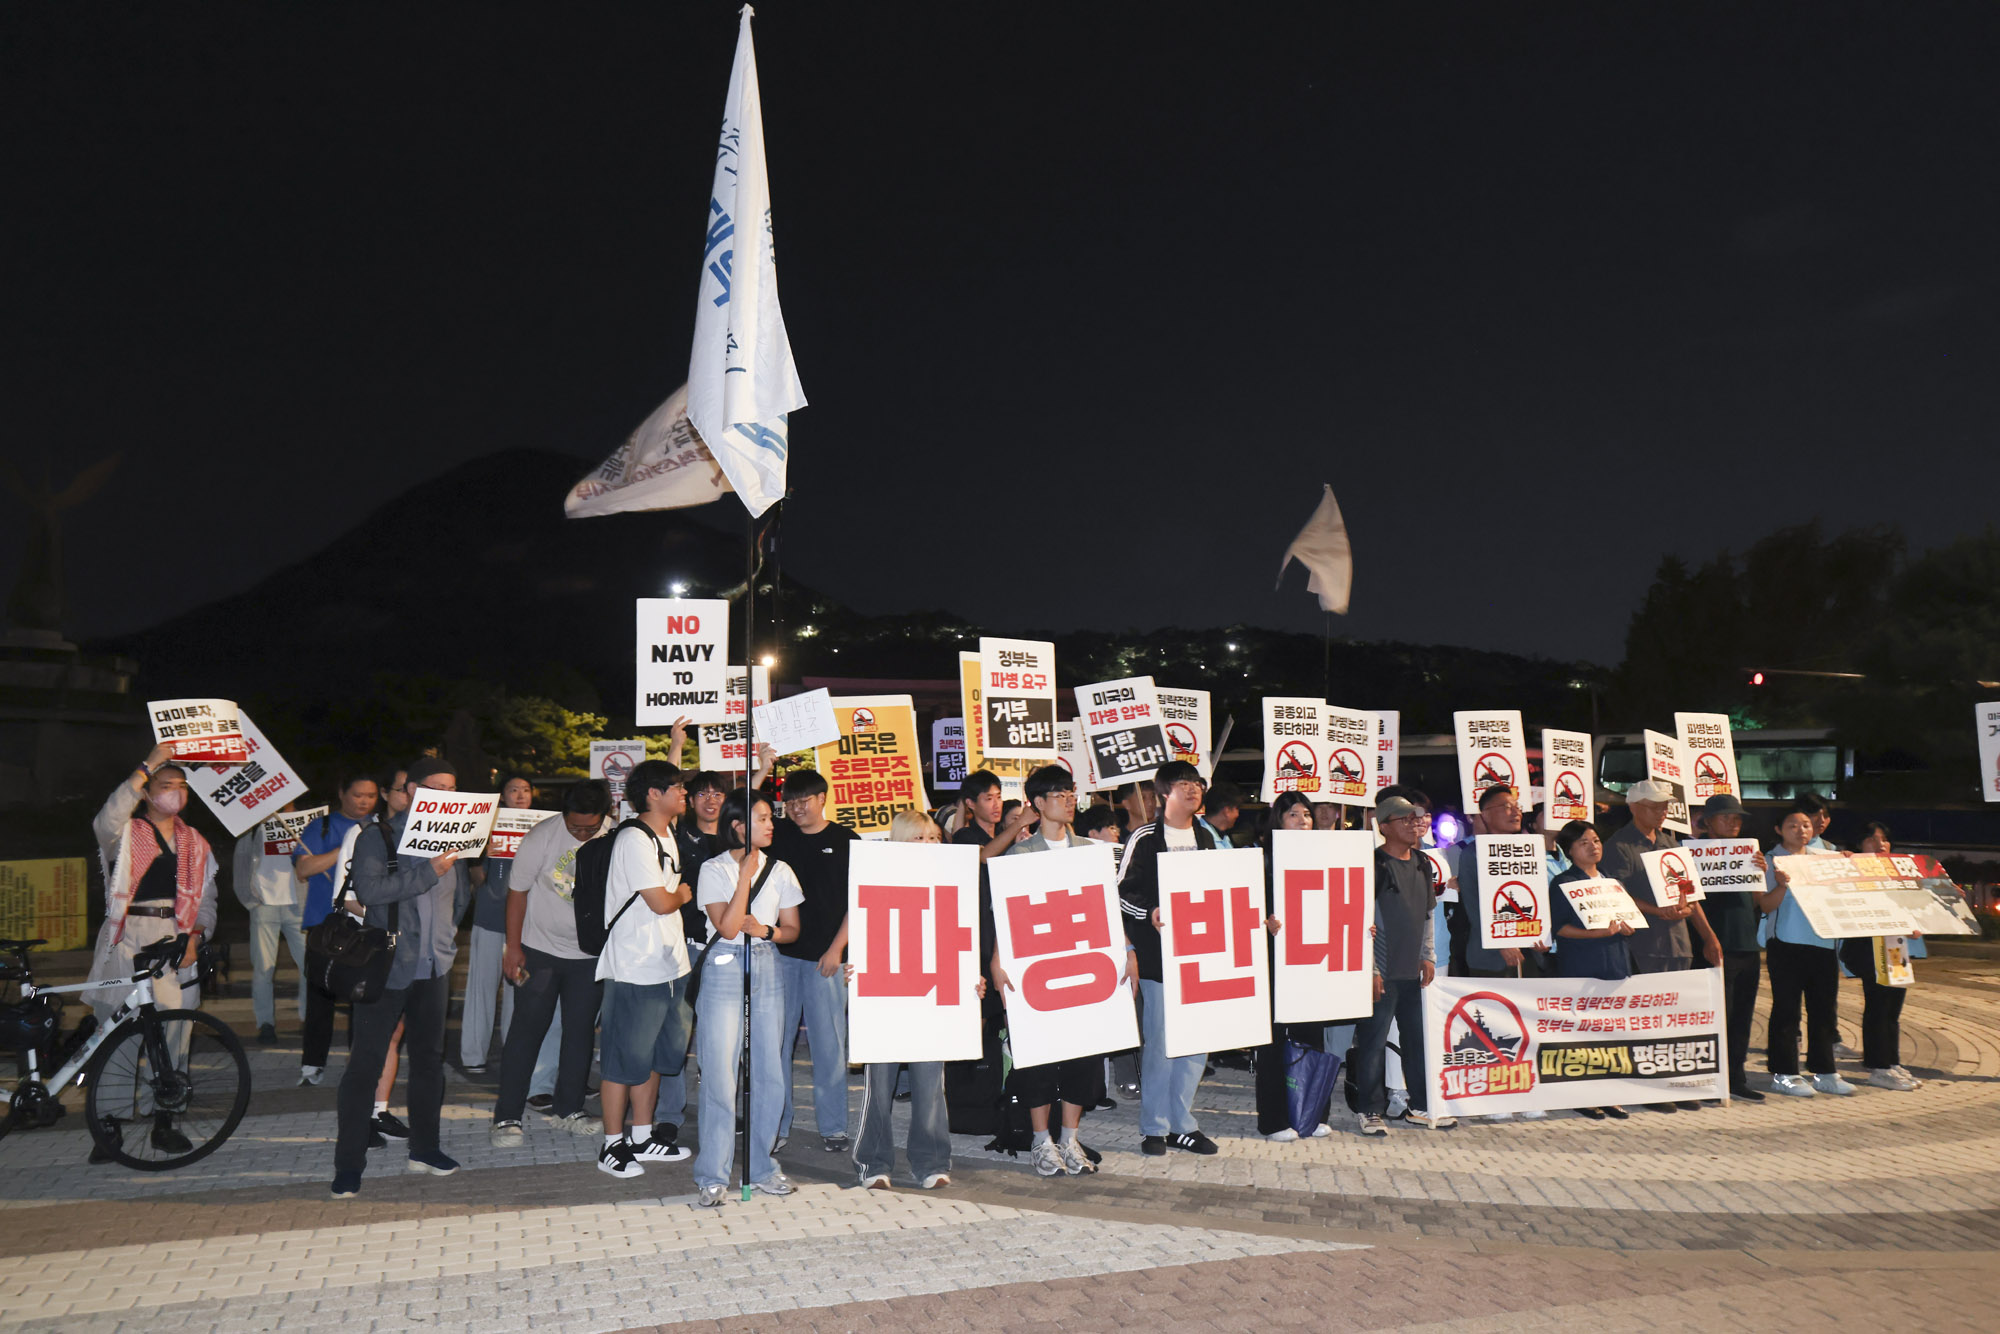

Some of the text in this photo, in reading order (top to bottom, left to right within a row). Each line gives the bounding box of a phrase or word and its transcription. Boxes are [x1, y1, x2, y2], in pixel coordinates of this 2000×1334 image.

[667, 615, 700, 635] NO
[651, 644, 714, 663] NAVY
[998, 650, 1038, 668] 정부는
[673, 671, 693, 685] TO
[990, 672, 1048, 690] 파병 요구
[646, 690, 718, 707] HORMUZ!
[1092, 687, 1135, 706] 미국의
[155, 705, 216, 722] 대미투자,
[991, 700, 1029, 722] 거부
[1088, 703, 1151, 726] 파병 압박
[1273, 706, 1317, 720] 굴종외교
[159, 720, 214, 738] 파병압박
[1007, 722, 1050, 745] 하라!
[1273, 722, 1319, 736] 중단하라!
[1468, 720, 1510, 733] 침략전쟁
[1687, 723, 1722, 735] 파병논의
[838, 732, 898, 755] 미국은
[1096, 730, 1138, 757] 규탄
[1470, 737, 1512, 749] 가담하는
[1688, 737, 1726, 749] 중단하라!
[830, 755, 911, 780] 호르무즈
[939, 753, 963, 769] 중단
[1116, 744, 1166, 773] 한다!
[210, 760, 267, 807] 전쟁을
[239, 772, 291, 810] 멈춰라!
[833, 779, 914, 805] 파병압박
[415, 801, 492, 815] DO NOT JOIN
[410, 820, 477, 834] A WAR OF
[405, 837, 486, 853] AGGRESSION!
[1488, 843, 1535, 857] 파병논의
[1705, 846, 1726, 857] NOT
[1729, 845, 1753, 856] JOIN
[1488, 861, 1538, 876] 중단하라!
[1701, 860, 1744, 871] WAR OF
[1701, 874, 1763, 886] GGRESSION!
[1569, 888, 1584, 899] DO
[1579, 902, 1587, 911] A
[1284, 866, 1364, 972] 대
[1492, 920, 1541, 937] 파병반대
[857, 884, 972, 1006] 파
[1005, 883, 1119, 1012] 병
[1169, 886, 1260, 1005] 반
[1537, 992, 1679, 1011] 미국은 침략전쟁 중단하라!
[1537, 1010, 1715, 1033] 정부는 파병압박 단호히 거부하라!
[1443, 1052, 1488, 1066] 호르무즈
[1541, 1040, 1716, 1077] 파병반대 평화행진
[1443, 1062, 1531, 1096] 파병반대
